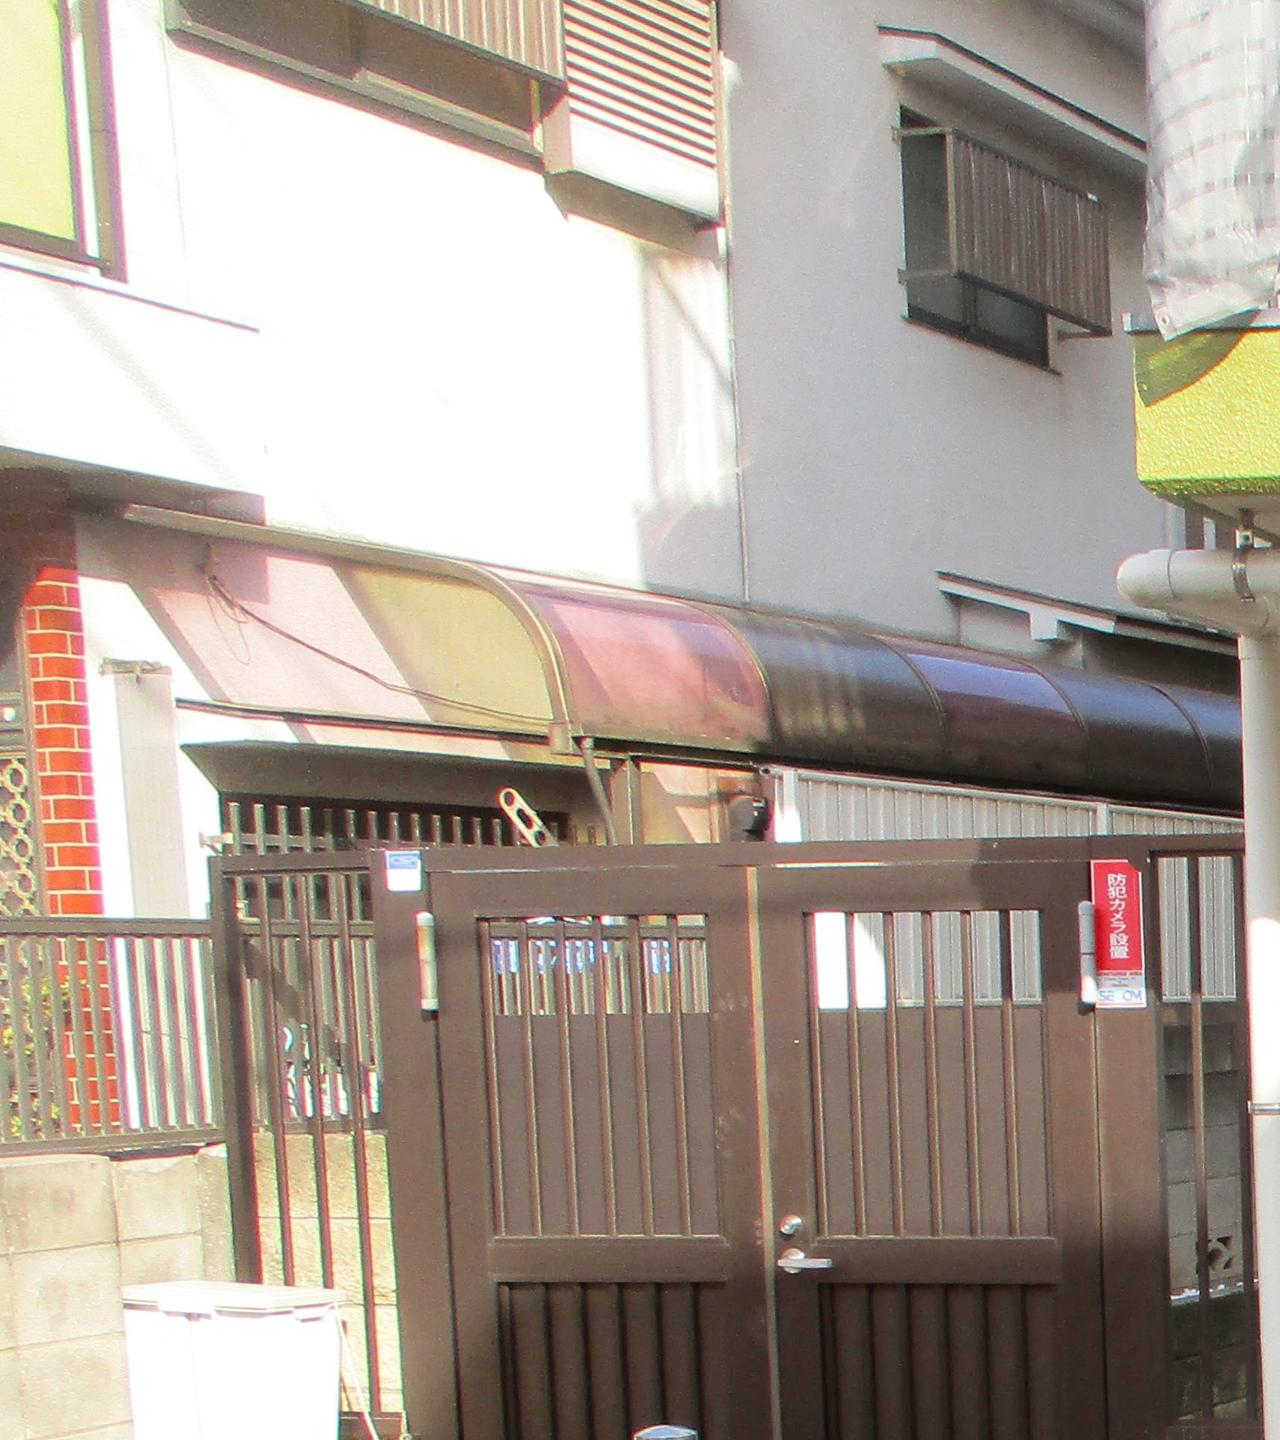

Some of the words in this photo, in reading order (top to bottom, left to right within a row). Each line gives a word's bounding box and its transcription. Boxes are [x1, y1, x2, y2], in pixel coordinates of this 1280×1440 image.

[1107, 873, 1129, 960] 防犯カメラ設置
[1099, 989, 1142, 1002] SEOM
